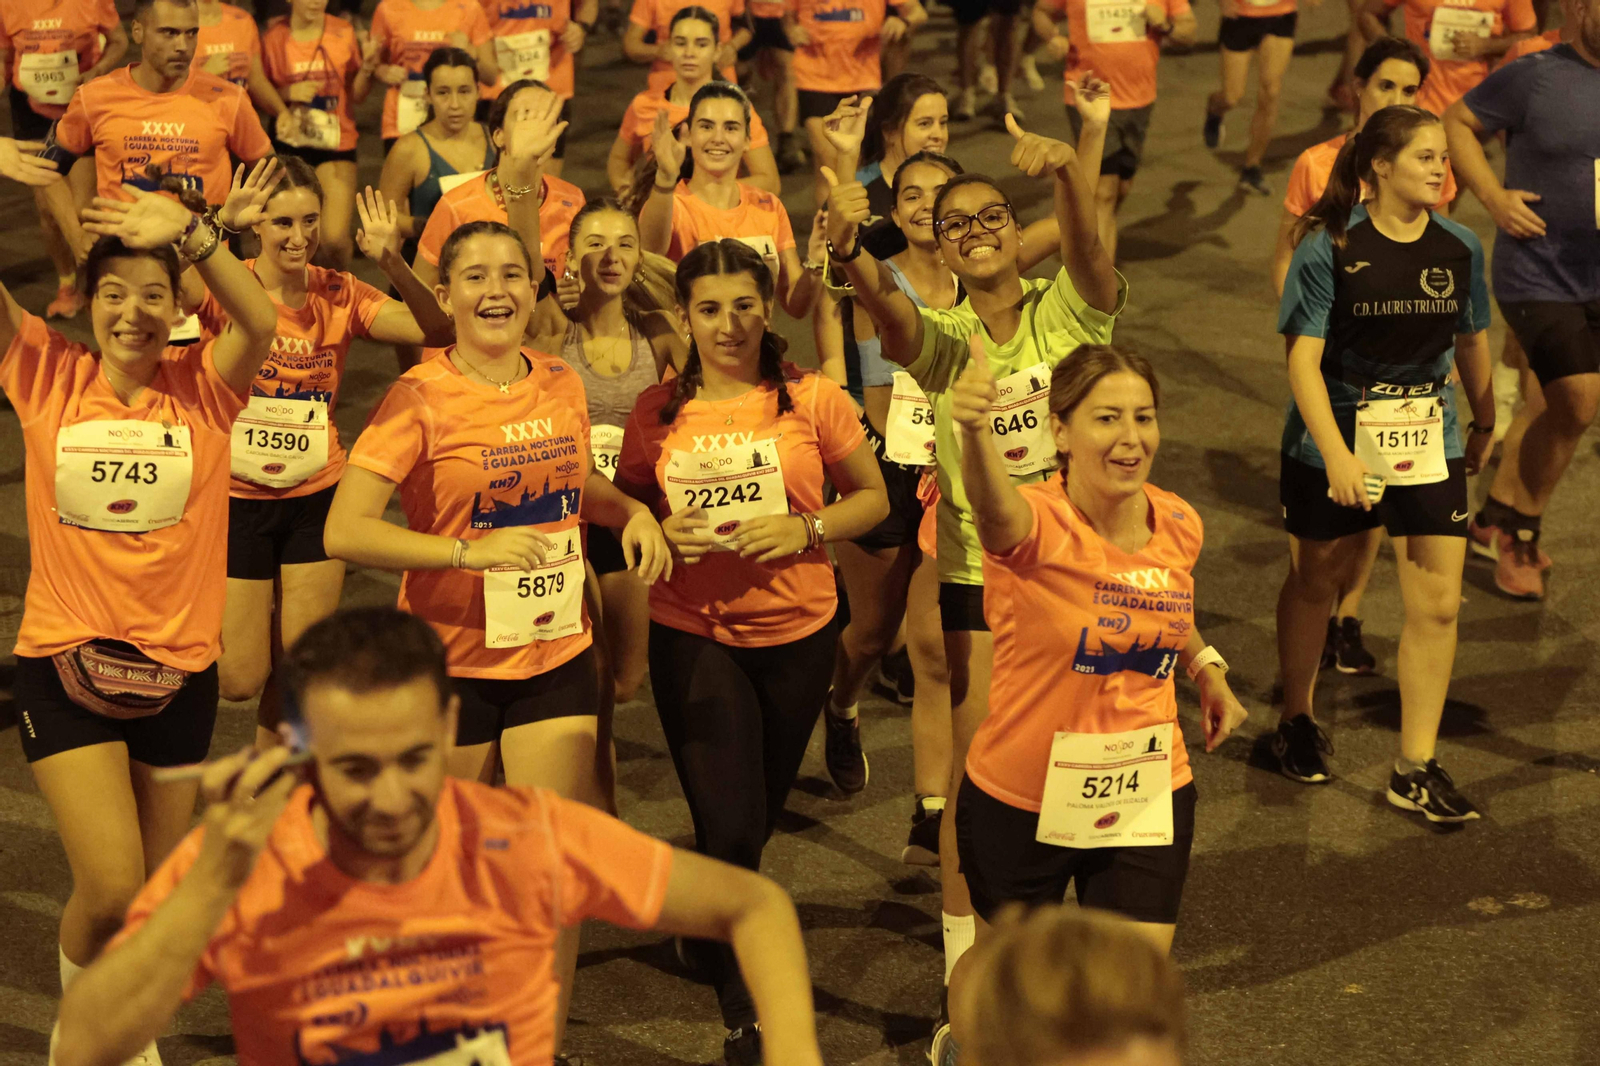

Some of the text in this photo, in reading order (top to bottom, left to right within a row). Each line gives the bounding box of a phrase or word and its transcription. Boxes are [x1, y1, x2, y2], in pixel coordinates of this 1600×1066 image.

[33, 19, 62, 30] XXXV
[34, 71, 65, 82] 8963
[142, 121, 185, 136] XXXV
[129, 142, 199, 154] GUADALQUIVIR
[160, 137, 199, 145] NOCTURNA
[1353, 299, 1459, 316] C.D. LAURUS TRIATLON
[266, 356, 333, 370] ADALQUIVIR
[287, 350, 333, 362] NOCTURNA
[1371, 381, 1433, 396] ZONE3
[500, 417, 553, 444] XXXV
[990, 409, 1038, 436] 646
[244, 428, 310, 452] 13590
[481, 444, 527, 458] CARRERA
[530, 435, 576, 450] NOCTURNA
[692, 430, 755, 453] XXXV
[1375, 428, 1428, 448] 15112
[490, 444, 578, 469] GUADALQUIVIR
[91, 461, 158, 484] 5743
[684, 482, 763, 510] 22242
[517, 571, 565, 599] 5879
[1109, 567, 1171, 590] XXXV
[1095, 581, 1192, 600] CARRERA NOCTURNA
[1101, 594, 1192, 613] GUADALQUIVIR
[1082, 769, 1139, 799] 5214
